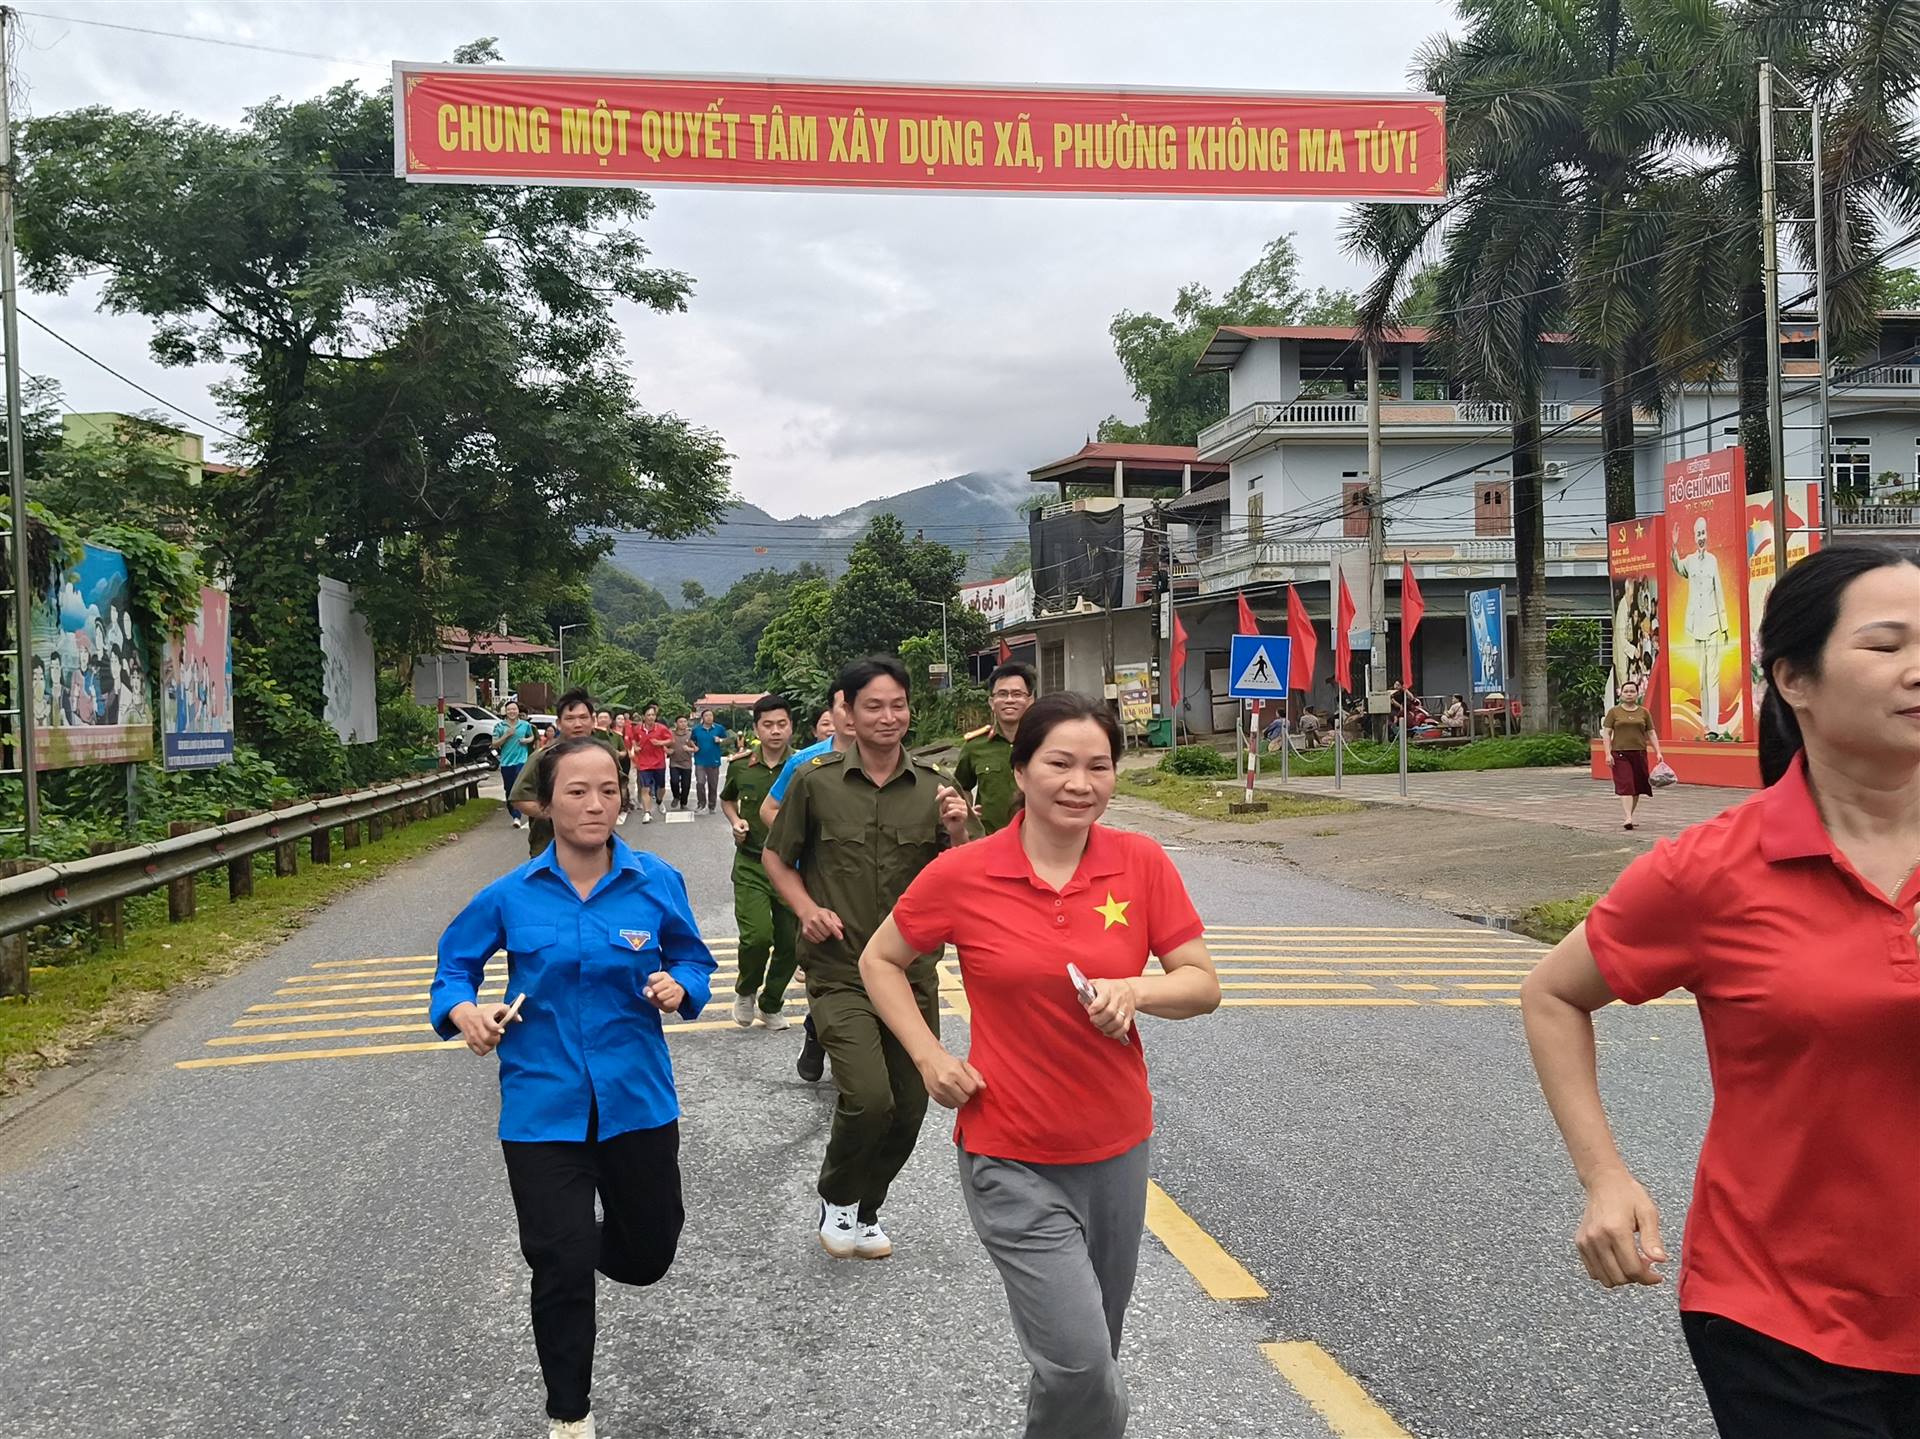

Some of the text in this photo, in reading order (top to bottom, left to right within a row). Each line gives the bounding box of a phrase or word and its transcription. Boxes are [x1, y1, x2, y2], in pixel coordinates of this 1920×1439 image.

[437, 96, 1418, 176] CHUNG MỘT QUYẾT TÂM XÂY DỰNG XÃ, PHƯỜNG KHÔNG MA TÚY!
[1669, 469, 1730, 504] HỒ CHÍ MINH
